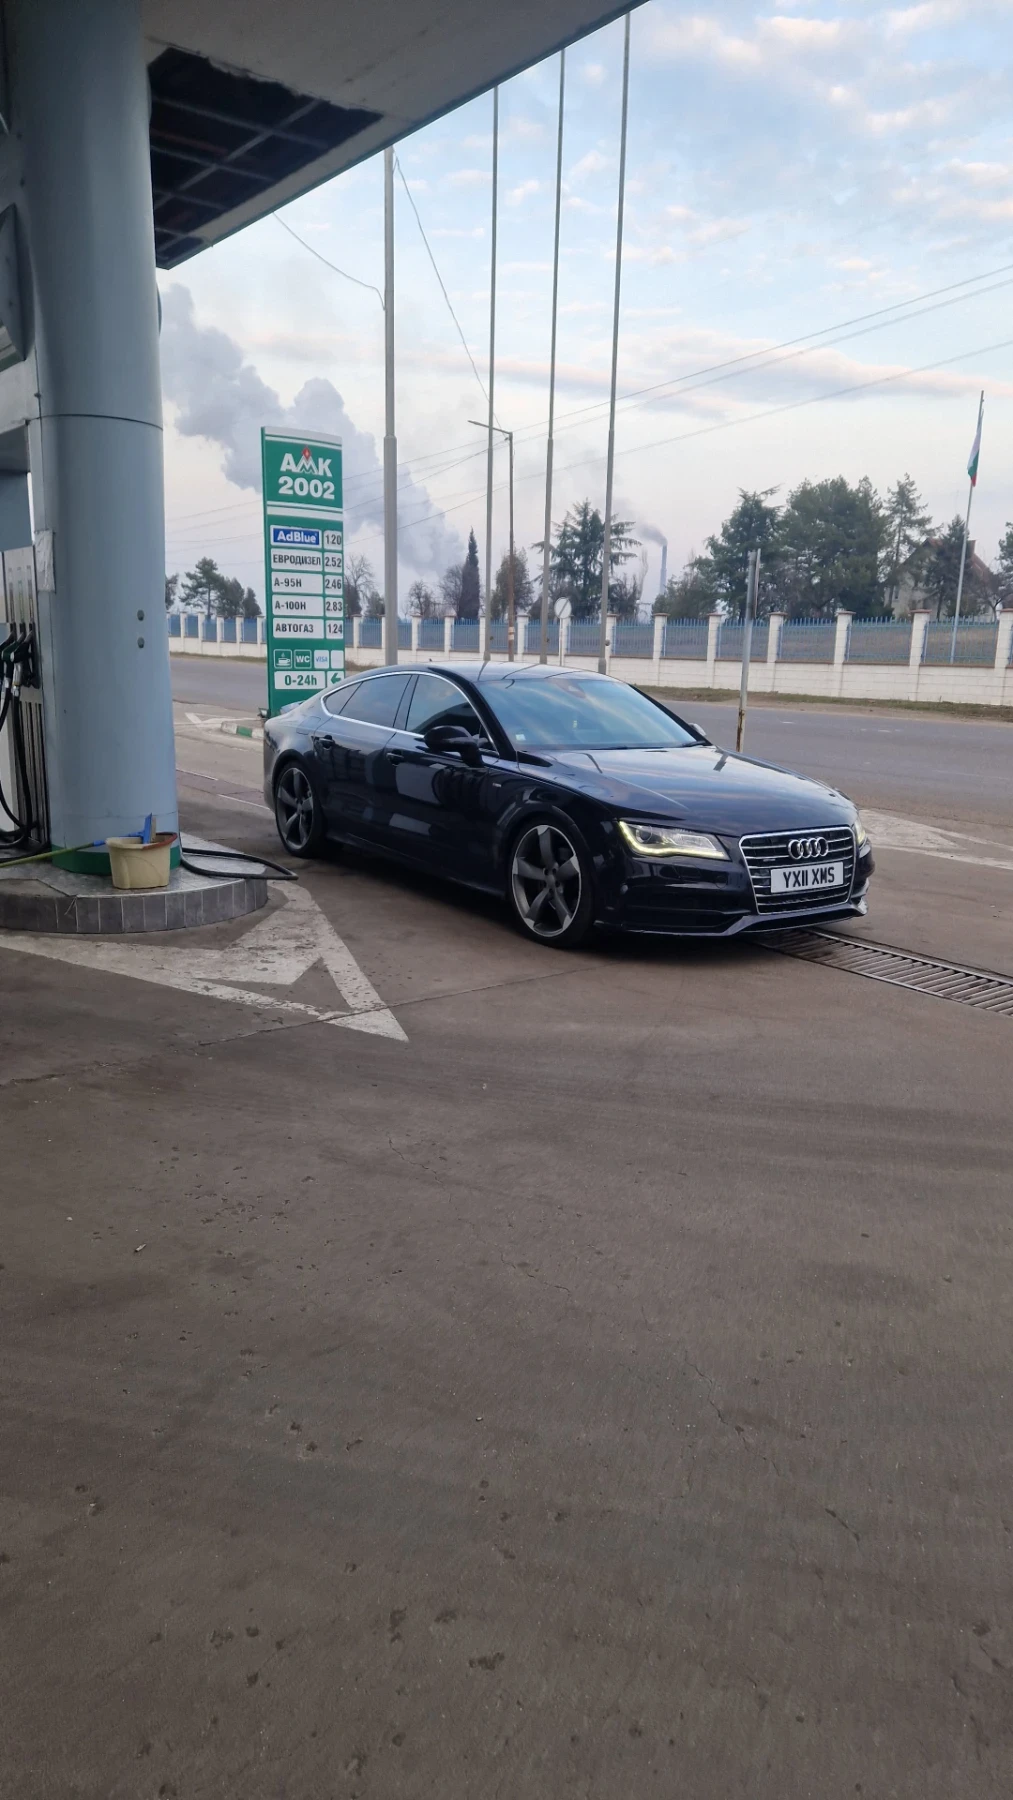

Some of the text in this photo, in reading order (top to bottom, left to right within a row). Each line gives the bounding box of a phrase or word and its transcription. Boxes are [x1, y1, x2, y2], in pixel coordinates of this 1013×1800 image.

[278, 475, 335, 500] 2002
[277, 530, 317, 543] AdBlue
[273, 554, 342, 568] ЕВРОДИЗЕЛ 2.52
[274, 577, 342, 590] А-95Н 2.46
[274, 600, 343, 612] А-100Н 2.83
[275, 623, 314, 633] АВТОГАЗ
[296, 655, 310, 663] WC
[284, 674, 317, 686] 0-24h
[783, 866, 835, 888] YX11 XMS
